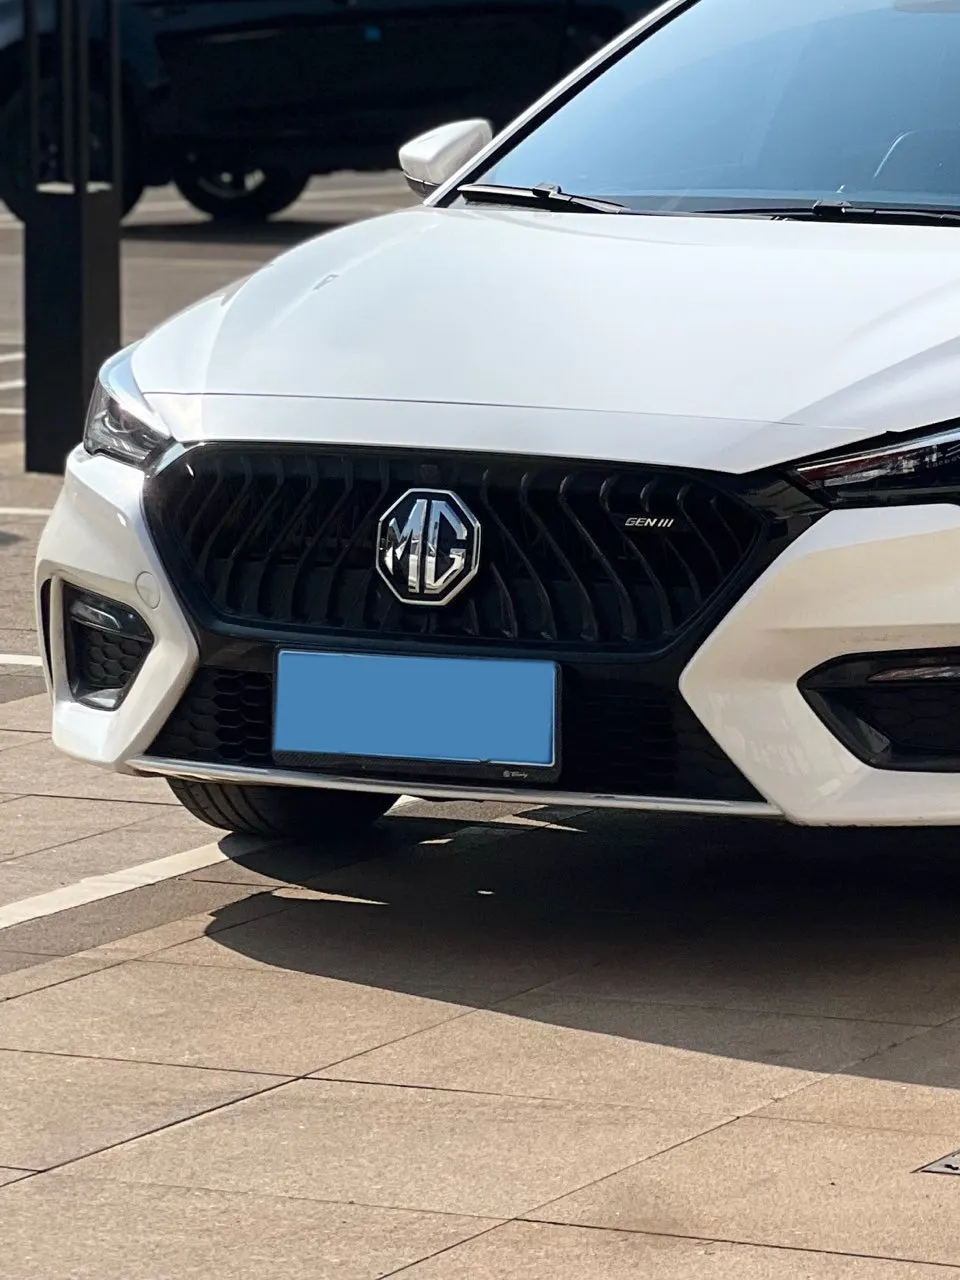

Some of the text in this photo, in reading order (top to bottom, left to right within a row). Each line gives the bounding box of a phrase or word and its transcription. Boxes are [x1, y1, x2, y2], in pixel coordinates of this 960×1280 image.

[385, 499, 468, 594] MG
[624, 517, 674, 528] GEN III
